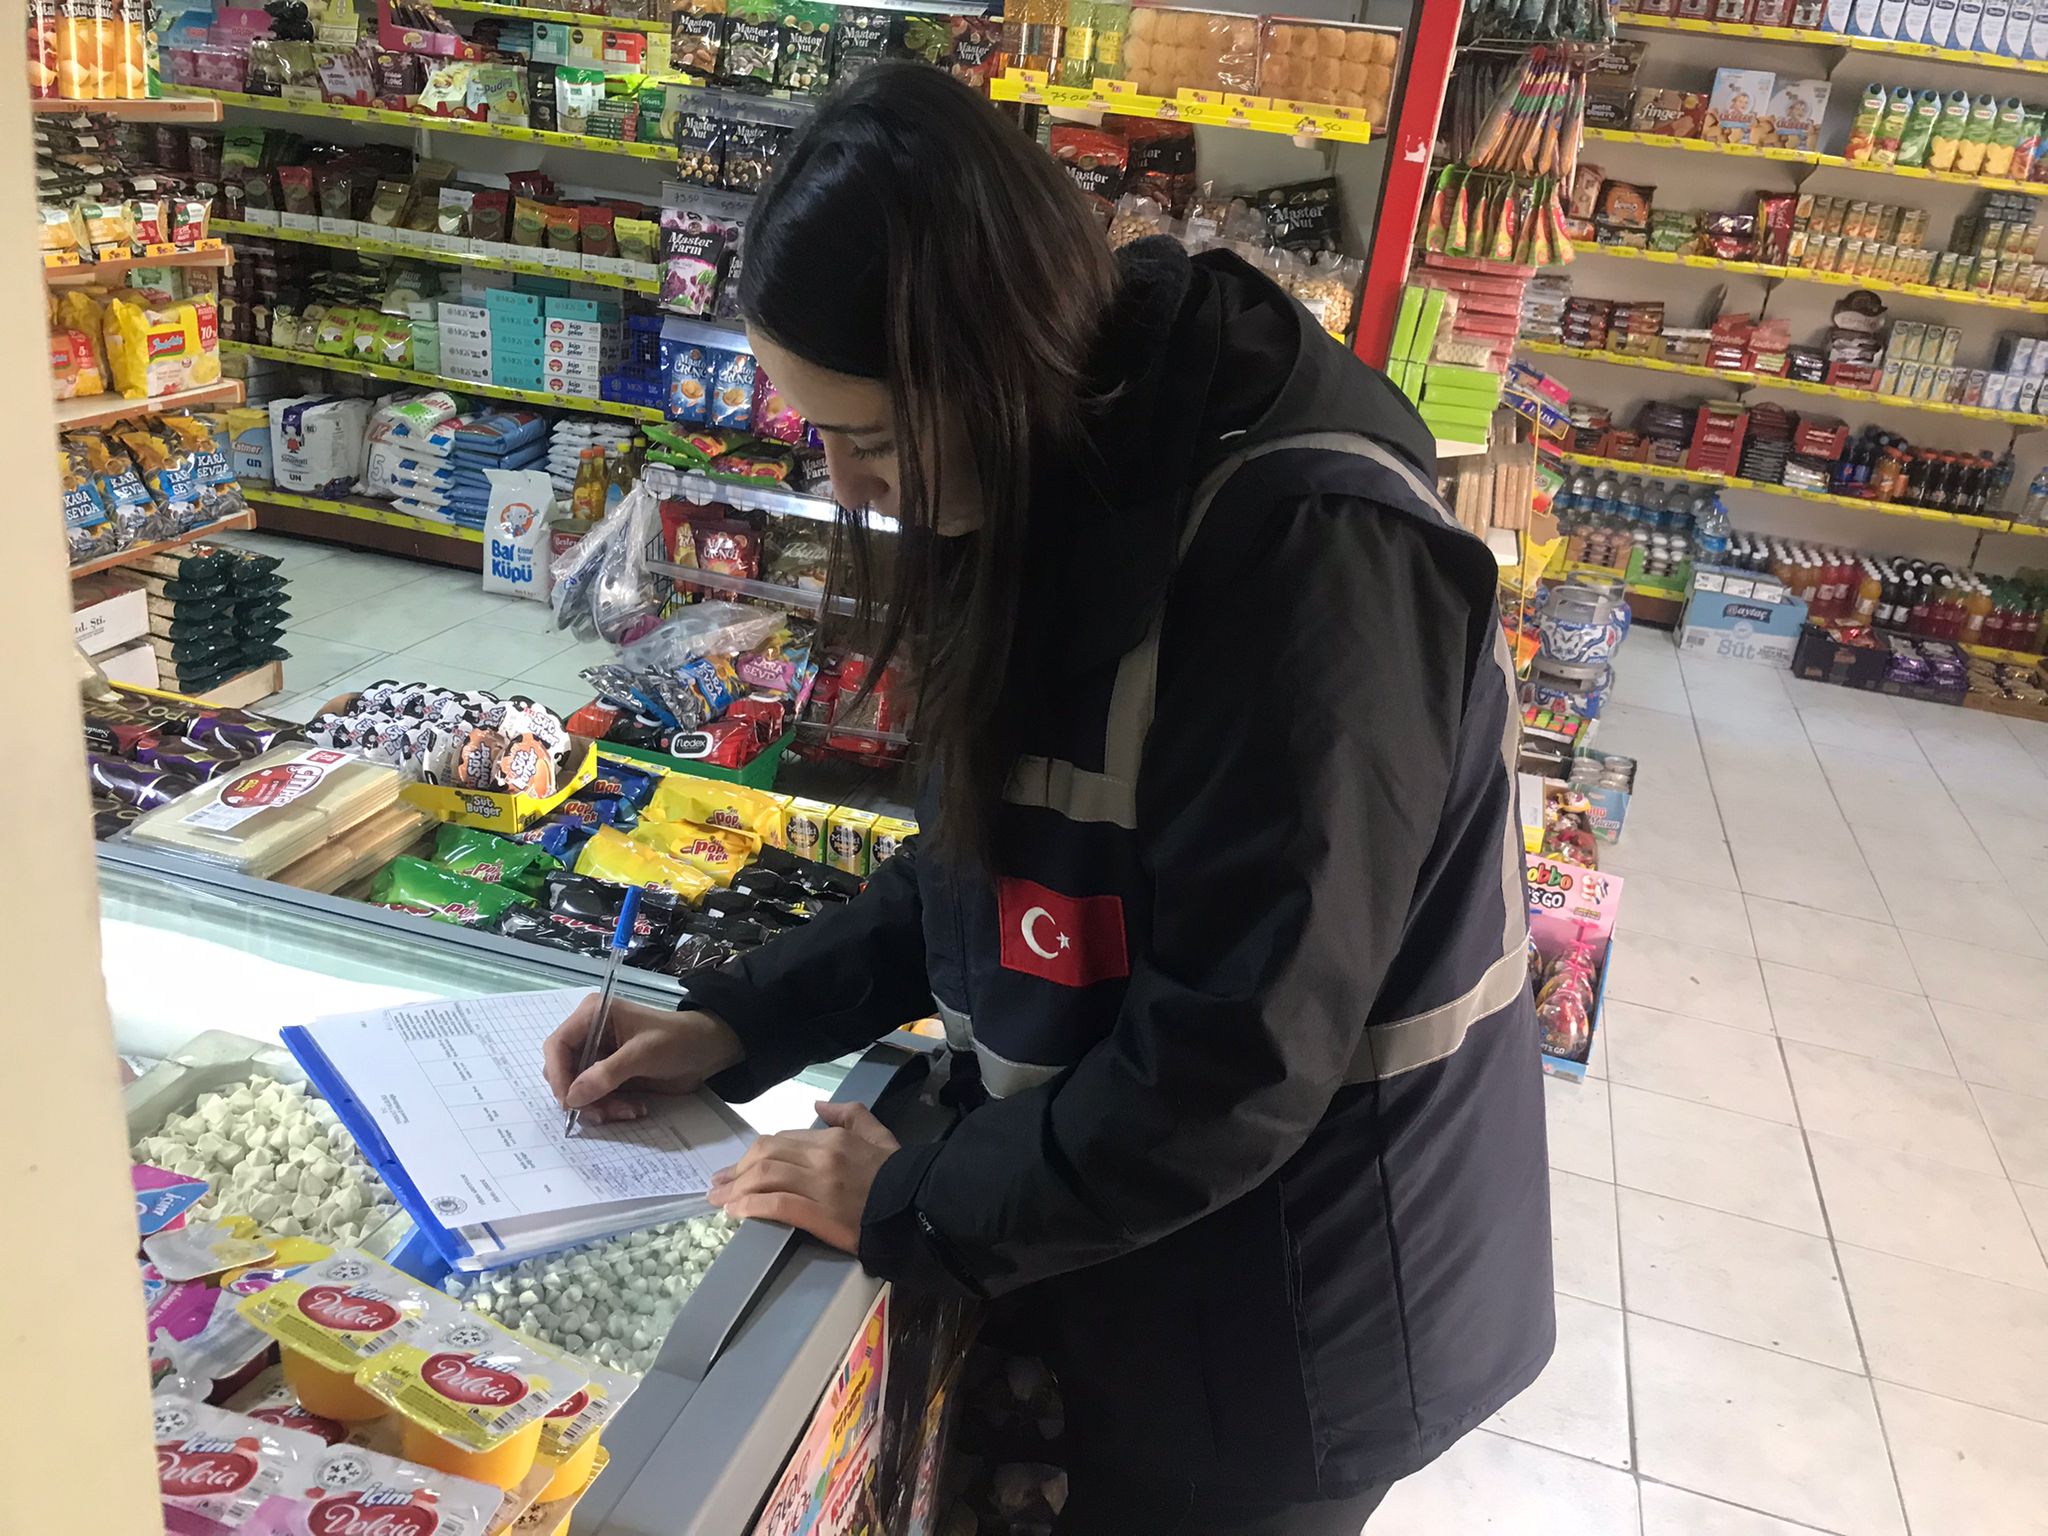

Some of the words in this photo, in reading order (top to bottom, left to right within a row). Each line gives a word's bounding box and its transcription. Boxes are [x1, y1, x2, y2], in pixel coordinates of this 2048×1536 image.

[681, 15, 713, 28] Master
[686, 22, 702, 34] Nut
[735, 22, 768, 37] Master
[743, 31, 758, 43] Nut
[790, 32, 823, 47] Master
[843, 26, 882, 42] Master
[851, 37, 869, 48] Nut
[957, 41, 989, 55] Master
[1640, 103, 1682, 121] finger
[684, 116, 717, 134] Master
[690, 129, 708, 140] Nut
[1275, 207, 1325, 225] Master
[1289, 218, 1314, 232] Nut
[668, 231, 713, 248] Master
[671, 241, 703, 256] Farm
[232, 443, 261, 456] Katmer
[197, 453, 226, 468] KARA
[246, 458, 262, 468] un
[111, 471, 138, 488] KAR
[167, 470, 190, 484] KAR
[197, 464, 230, 480] SEVDA
[172, 481, 191, 498] SEV
[65, 491, 92, 507] KARA
[66, 504, 101, 520] SEVDA
[491, 539, 516, 561] Bal
[491, 559, 533, 583] Küpü
[1717, 639, 1756, 660] Süt
[700, 661, 724, 695] KARA
[743, 666, 784, 682] SEVDA
[676, 737, 707, 748] flodex
[467, 750, 483, 776] Süt
[511, 750, 529, 776] Süt
[473, 794, 495, 807] Süt
[465, 803, 503, 819] Burger
[693, 839, 726, 857] Pop
[706, 852, 730, 863] kek
[1526, 862, 1574, 891] obbo
[1541, 893, 1564, 908] GO
[307, 1292, 384, 1328] Dolcia
[431, 1358, 512, 1402] Dolcia
[179, 1431, 237, 1454] İçim
[357, 1481, 414, 1508] İçim
[324, 1502, 422, 1536] Dolcia
